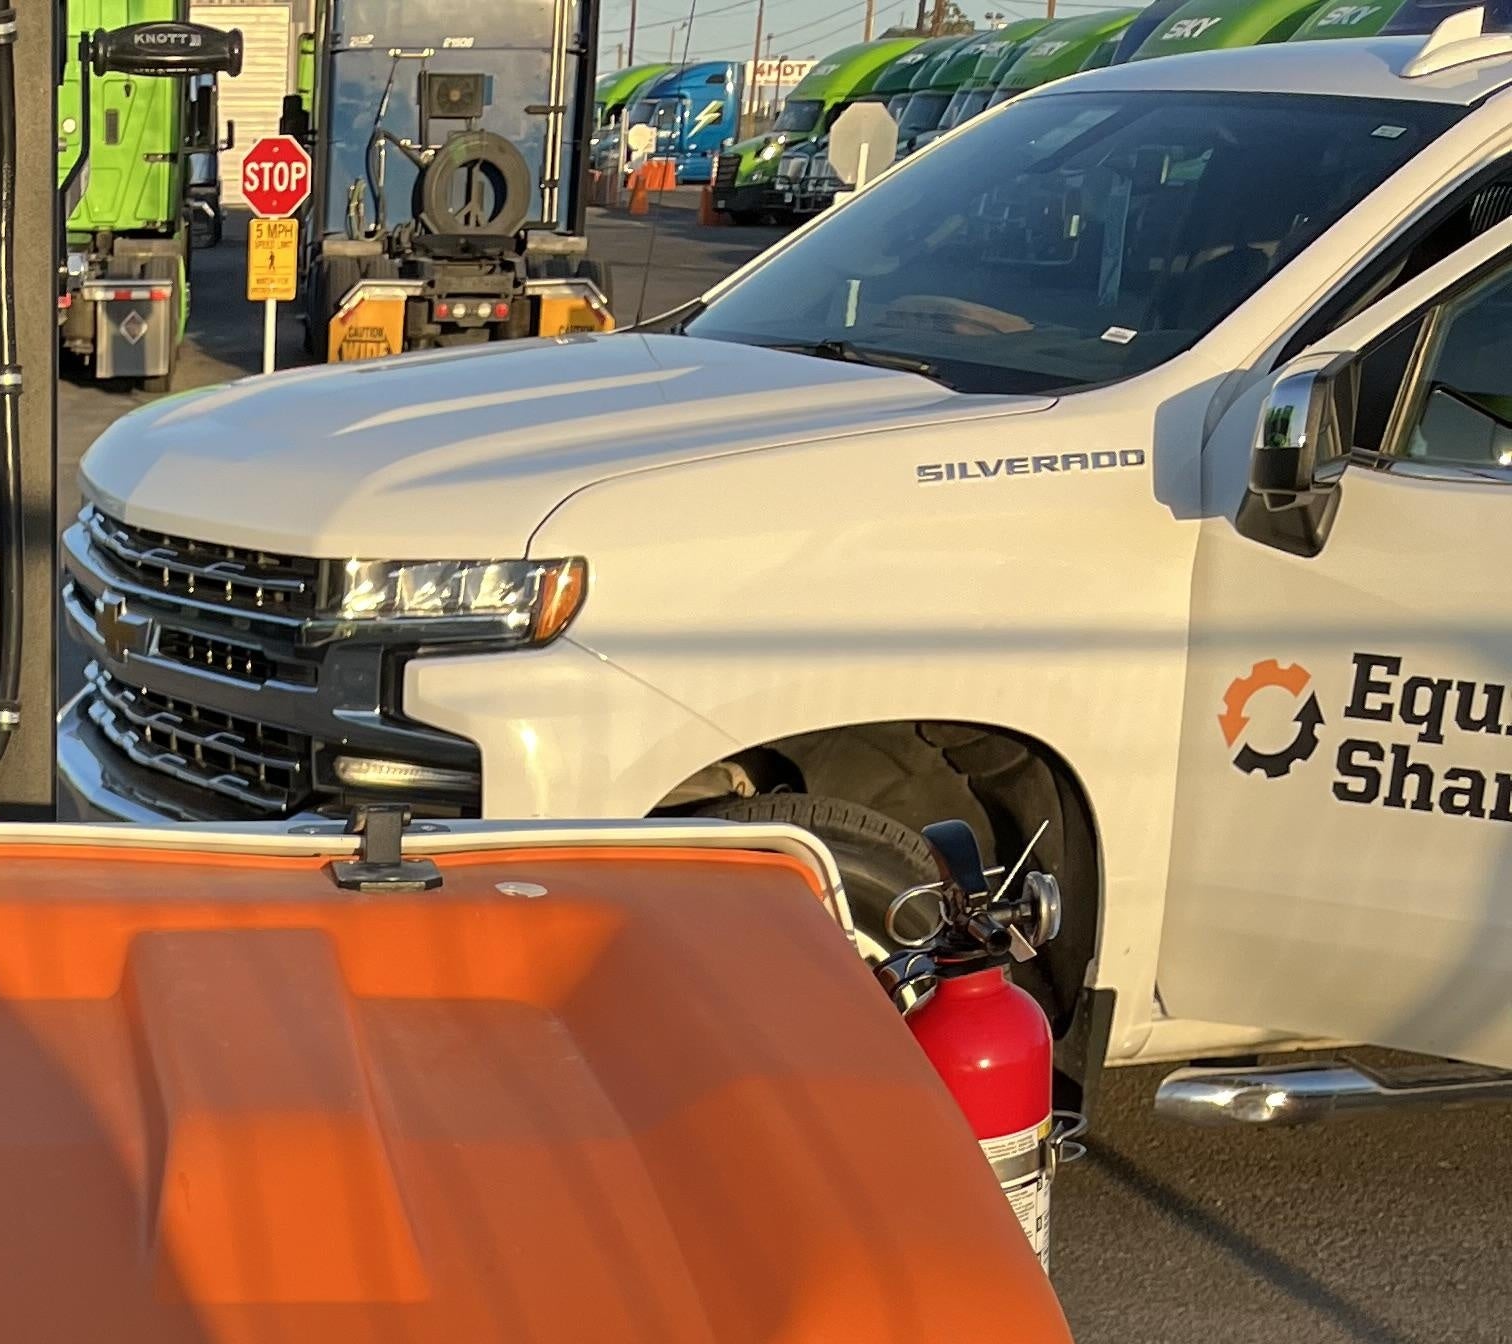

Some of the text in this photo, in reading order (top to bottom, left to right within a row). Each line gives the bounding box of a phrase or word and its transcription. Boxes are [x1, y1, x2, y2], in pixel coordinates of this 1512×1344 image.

[1317, 6, 1383, 25] SKY
[134, 33, 188, 45] KNOTT
[1161, 17, 1222, 40] SKY
[244, 162, 307, 192] STOP
[256, 224, 293, 239] 5 MPH
[348, 326, 384, 338] CAUTION
[916, 449, 1145, 484] SILVERADO
[1343, 652, 1512, 745] Equ
